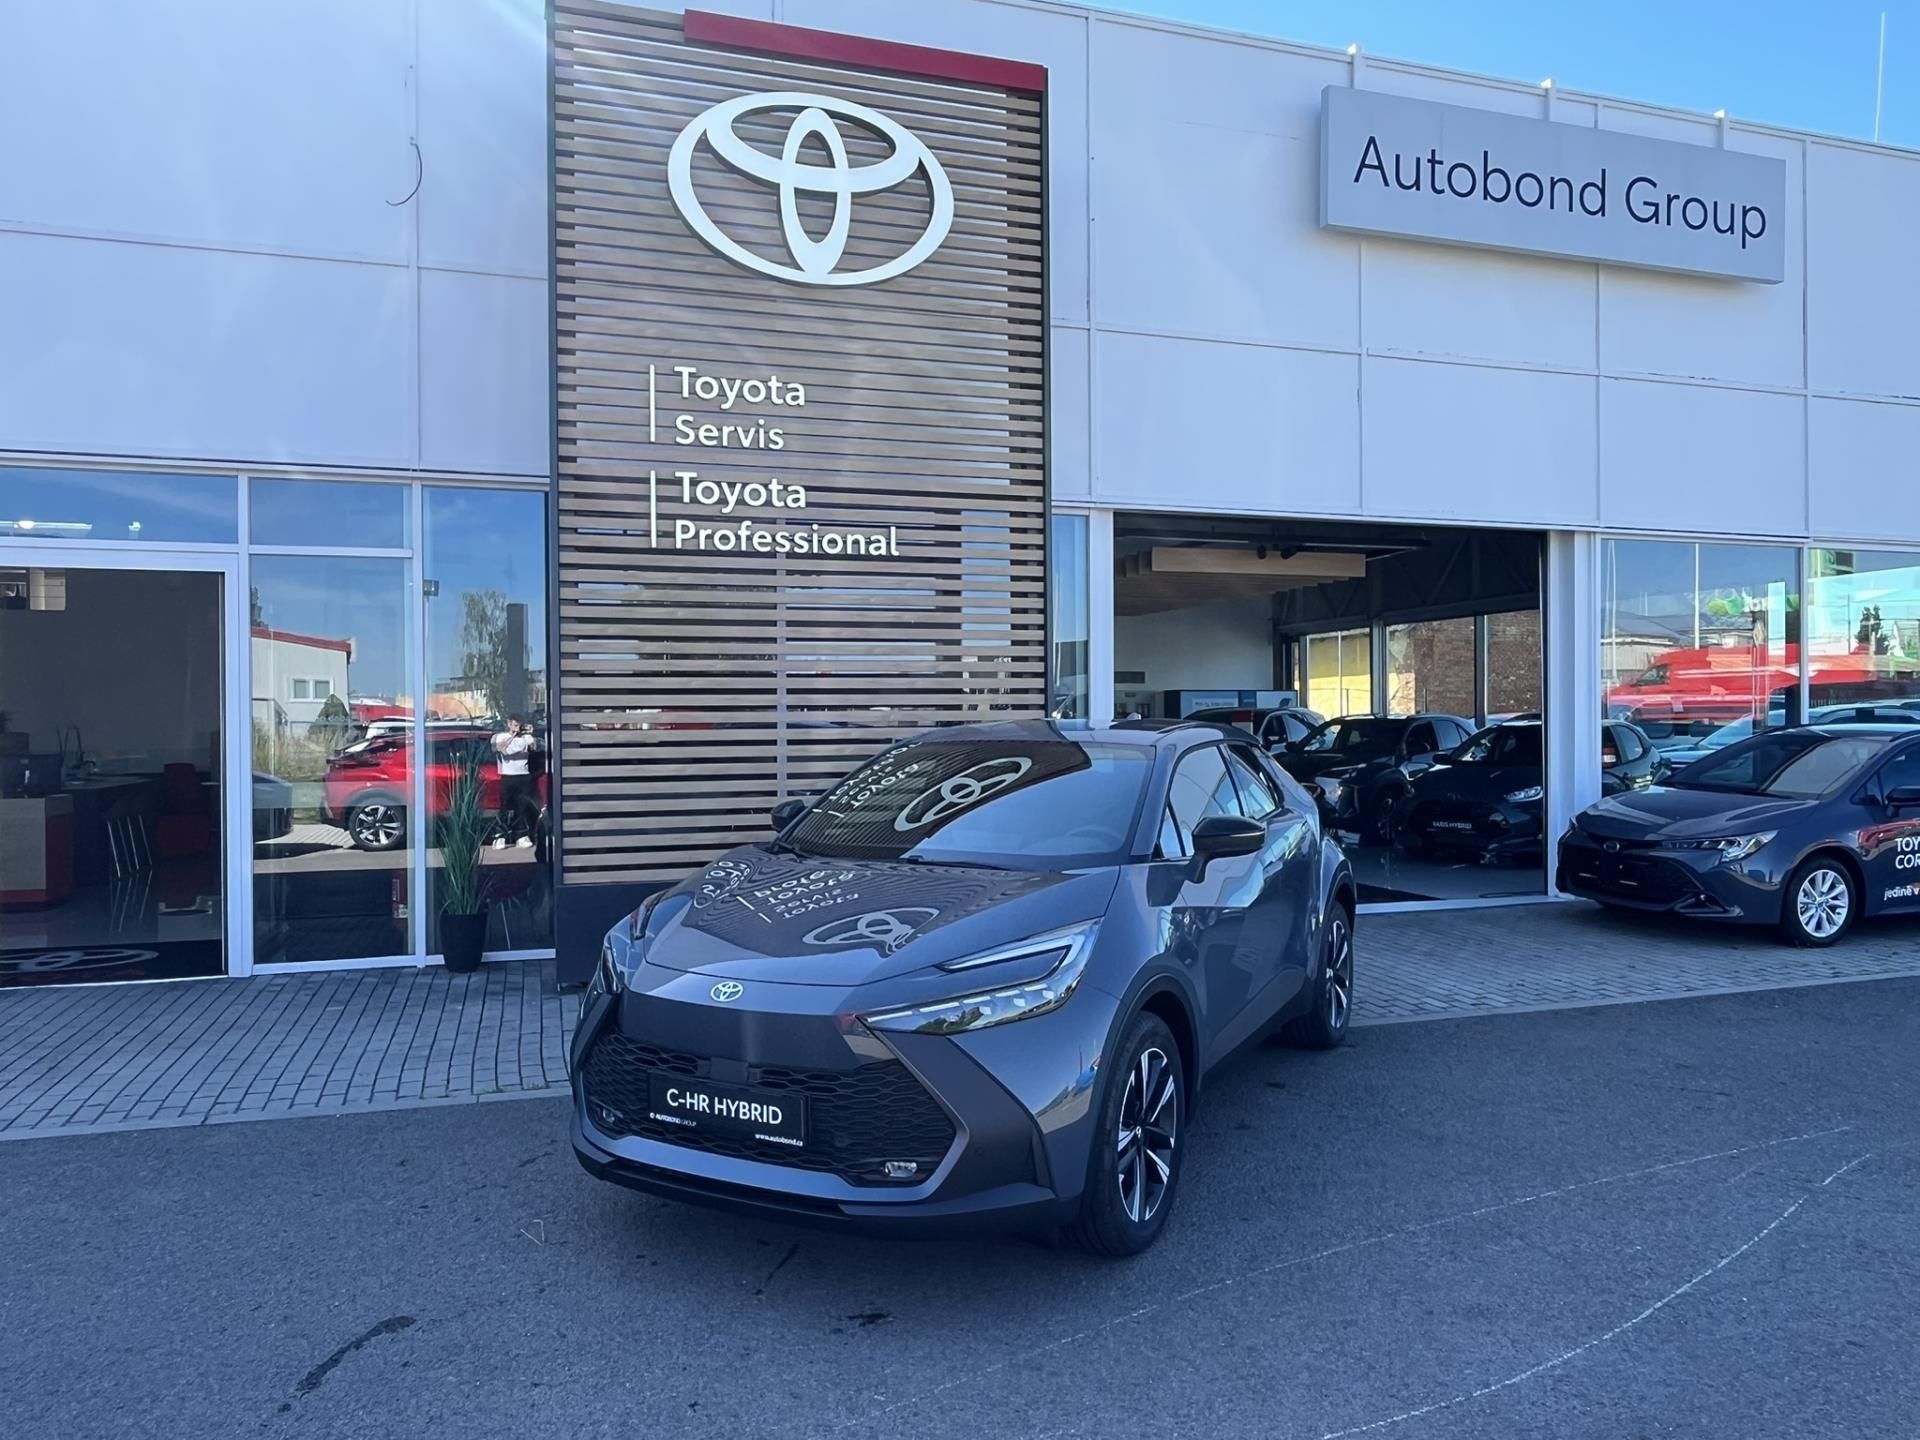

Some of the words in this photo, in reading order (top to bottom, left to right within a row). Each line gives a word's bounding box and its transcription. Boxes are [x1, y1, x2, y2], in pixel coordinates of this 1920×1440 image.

[1353, 135, 1608, 218] Autobond
[1625, 176, 1768, 249] Group
[674, 366, 806, 410] Toyota
[675, 415, 785, 450] Servis
[674, 471, 807, 513] Toyota
[674, 519, 900, 556] Professional
[666, 1088, 710, 1113] C-HR
[714, 1096, 782, 1125] HYBRID
